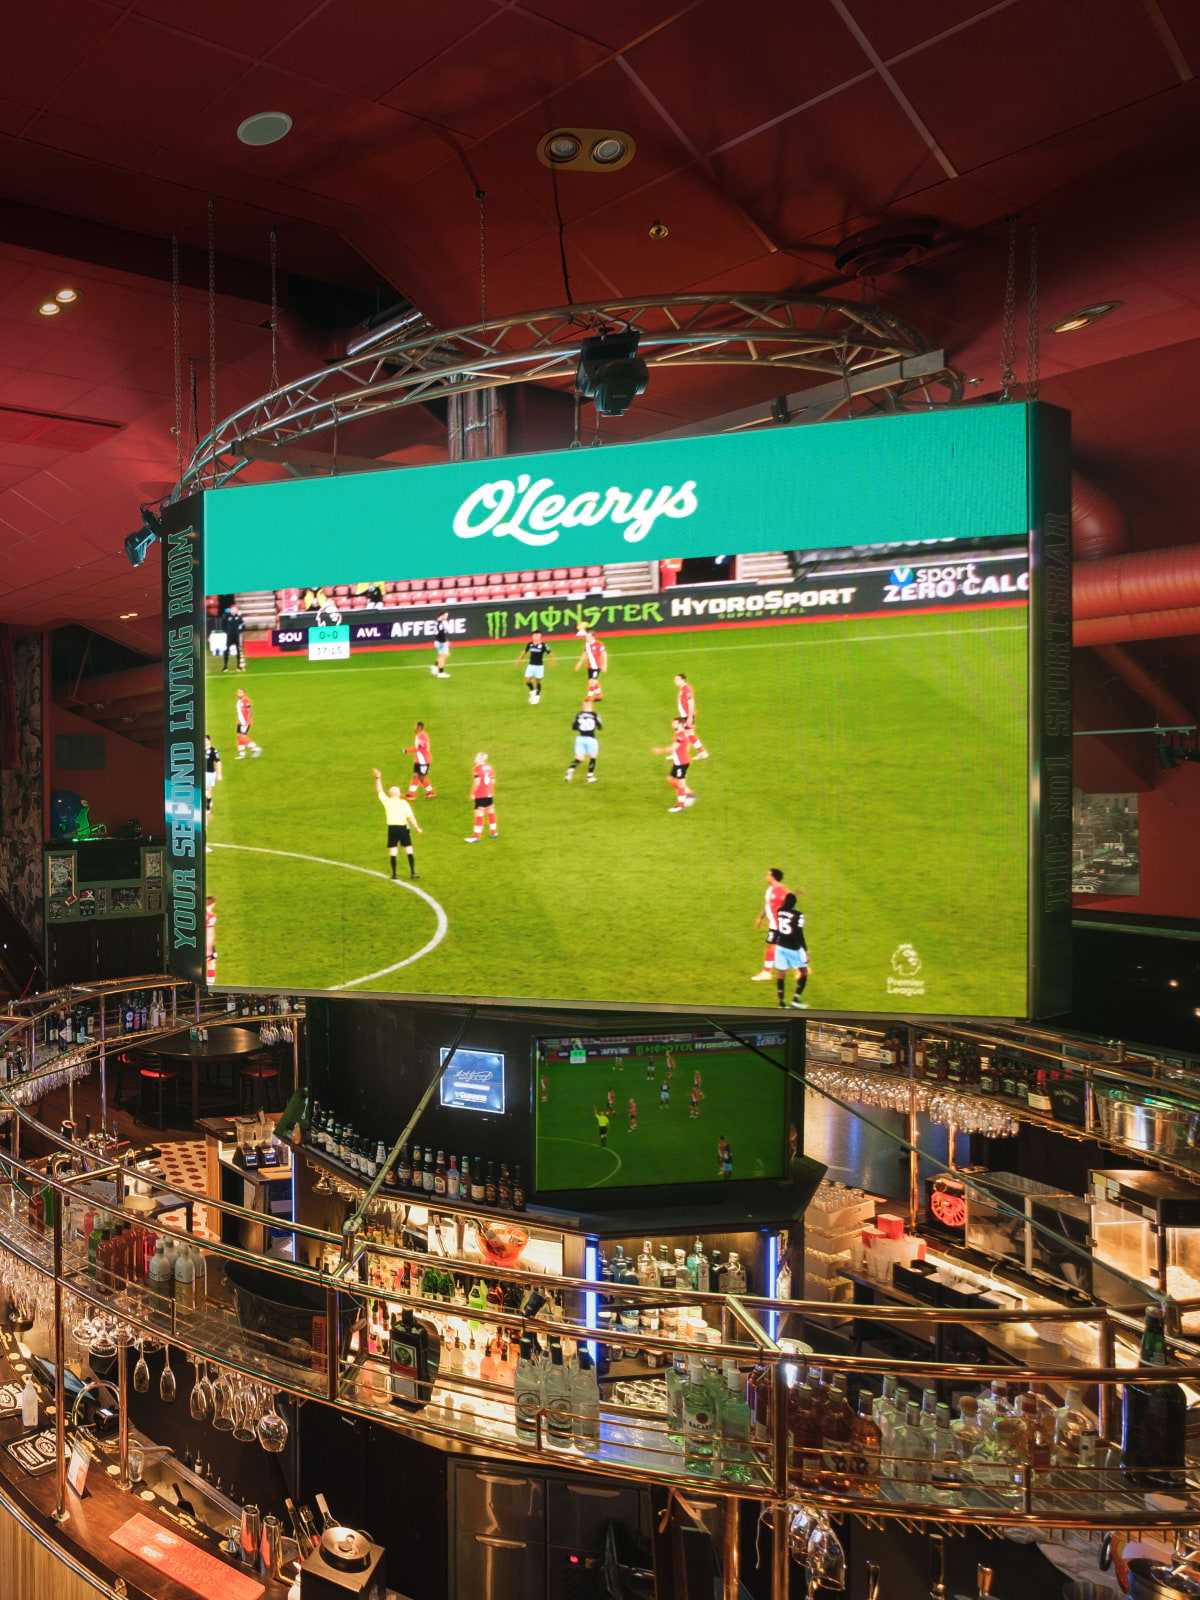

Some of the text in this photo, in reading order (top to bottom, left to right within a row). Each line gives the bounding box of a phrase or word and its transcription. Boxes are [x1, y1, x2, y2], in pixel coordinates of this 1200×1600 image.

[453, 474, 697, 546] O'Learys
[916, 564, 976, 583] sport
[883, 579, 957, 603] ZERO
[717, 607, 807, 620] SUPER FUEL
[278, 632, 303, 643] SOU
[319, 630, 338, 640] 0-0
[356, 627, 381, 638] AVL
[167, 525, 197, 949] YOUR SECOND LIVING ROOM
[777, 916, 792, 935] 15
[887, 976, 925, 987] Premier
[886, 986, 926, 997] League
